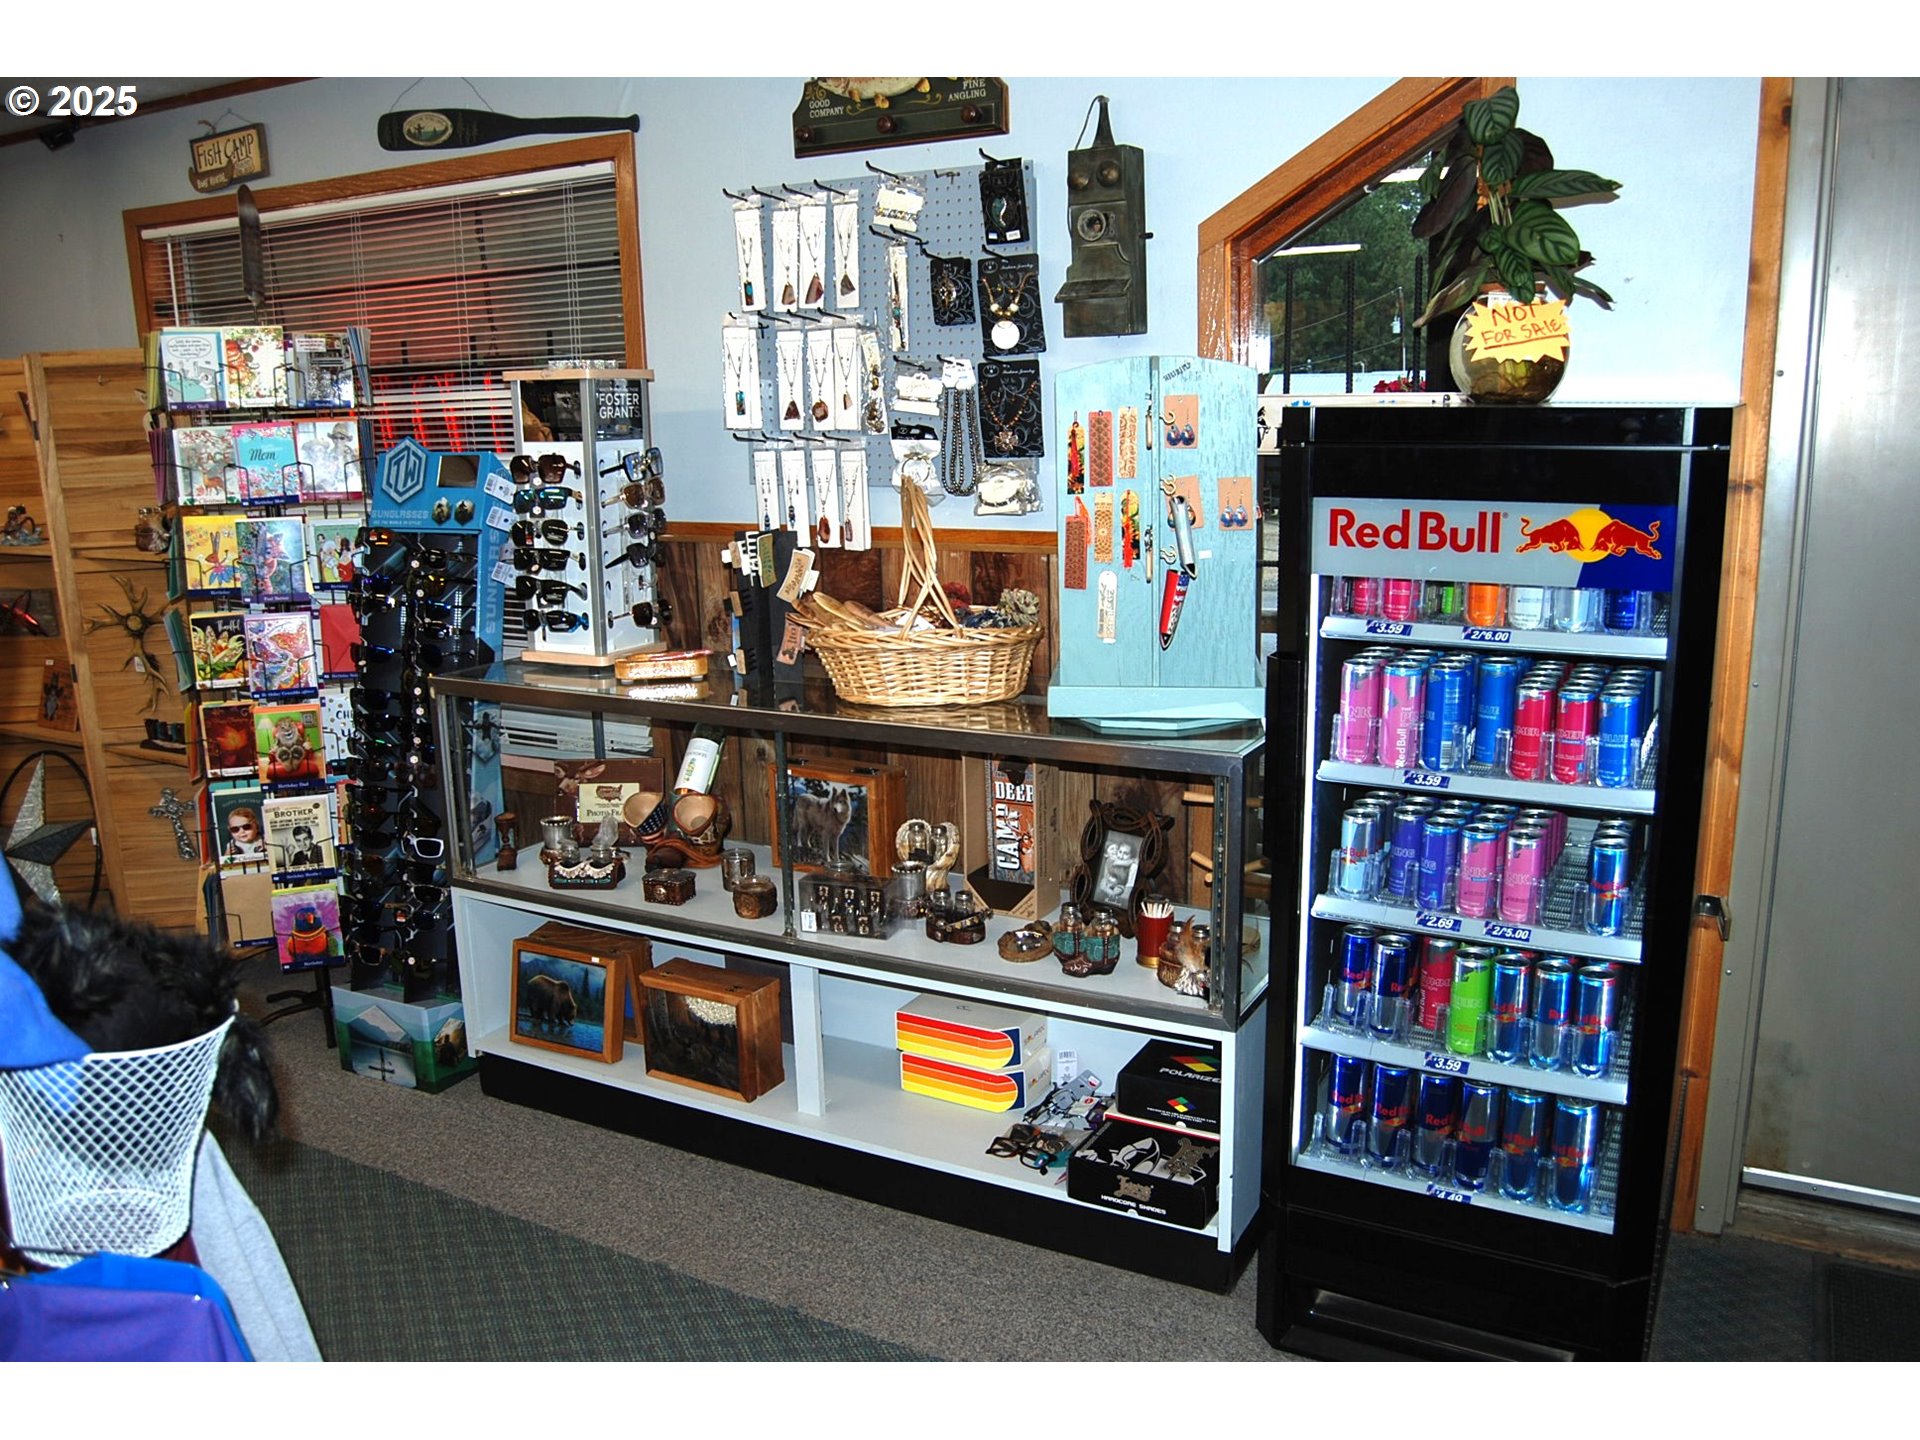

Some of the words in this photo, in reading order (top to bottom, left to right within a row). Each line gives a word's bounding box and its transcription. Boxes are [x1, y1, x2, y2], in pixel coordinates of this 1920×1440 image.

[962, 79, 987, 90] FINE
[947, 88, 987, 102] ANGLING
[809, 99, 831, 109] GOOD
[809, 107, 845, 119] COMPANY
[195, 140, 223, 169] FISH
[224, 133, 254, 162] CAMP
[1491, 303, 1539, 327] NOT
[1481, 329, 1516, 344] FOR
[1520, 319, 1561, 339] SALE
[599, 406, 641, 419] GRANTS
[249, 448, 278, 461] Mom
[1329, 508, 1411, 550] Red
[1418, 510, 1501, 554] Bull
[1396, 728, 1407, 747] Bull
[274, 808, 314, 819] BROTHER
[995, 803, 1020, 870] CAMP
[1159, 1067, 1222, 1084] POLARIZE
[1425, 1113, 1450, 1126] Red
[1101, 1195, 1137, 1208] HARDCORE
[1138, 1203, 1167, 1215] SHADES
